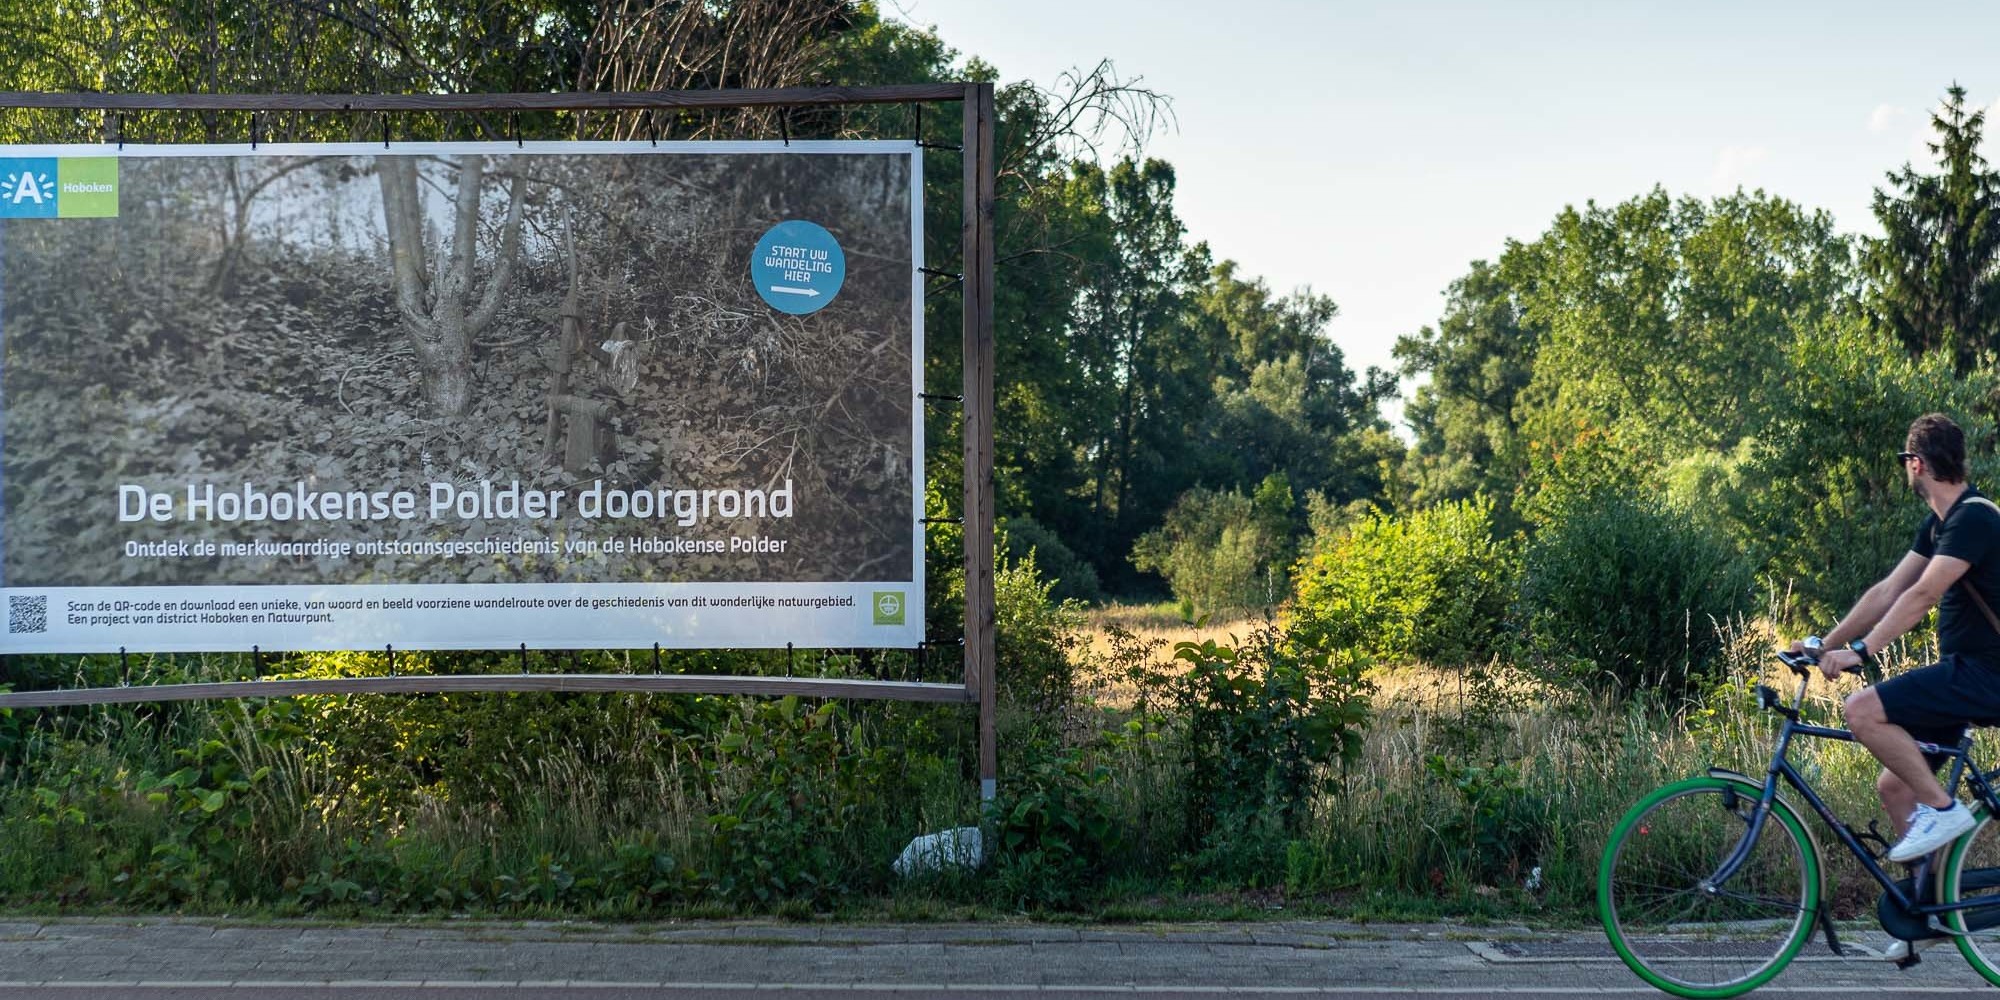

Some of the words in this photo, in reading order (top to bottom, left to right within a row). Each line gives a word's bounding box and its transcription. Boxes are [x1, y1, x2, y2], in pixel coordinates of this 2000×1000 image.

[12, 171, 43, 204] A
[63, 182, 113, 193] Hoboken
[771, 245, 807, 259] START
[809, 249, 828, 261] UW
[765, 256, 832, 273] WANDELING
[784, 270, 811, 283] HIER
[118, 484, 173, 523] De
[187, 481, 415, 523] Hobokense
[430, 480, 565, 520] Polder
[578, 479, 793, 527] doorgrond
[125, 540, 189, 557] Ontdek
[193, 540, 216, 557] de
[220, 538, 350, 559] merkwaardige
[355, 537, 559, 558] ontstaansgeschiedenis
[564, 541, 597, 554] van
[602, 537, 625, 554] de
[629, 537, 725, 554] Hobokense
[730, 536, 787, 553] Polder
[67, 601, 94, 612] Scan
[97, 601, 111, 612] de
[114, 600, 160, 612] QR-code
[164, 602, 177, 612] en
[180, 600, 235, 611] download
[238, 602, 258, 611] een
[261, 599, 301, 612] unieke,
[304, 602, 325, 610] van
[328, 599, 363, 610] woord
[366, 601, 380, 610] en
[382, 598, 413, 610] beeld
[416, 598, 471, 609] voorziene
[474, 597, 544, 609] wandelroute
[547, 599, 572, 608] over
[575, 597, 589, 608] de
[592, 596, 665, 609] geschiedenis
[667, 598, 688, 607] van
[691, 595, 707, 607] dit
[710, 595, 775, 609] wonderlijke
[778, 595, 856, 609] natuurgebied.
[67, 614, 88, 624] Een
[90, 613, 130, 626] project
[132, 615, 154, 624] van
[156, 612, 198, 624] district
[200, 612, 249, 623] Hoboken
[251, 614, 265, 622] en
[268, 611, 334, 624] Natuurpunt.
